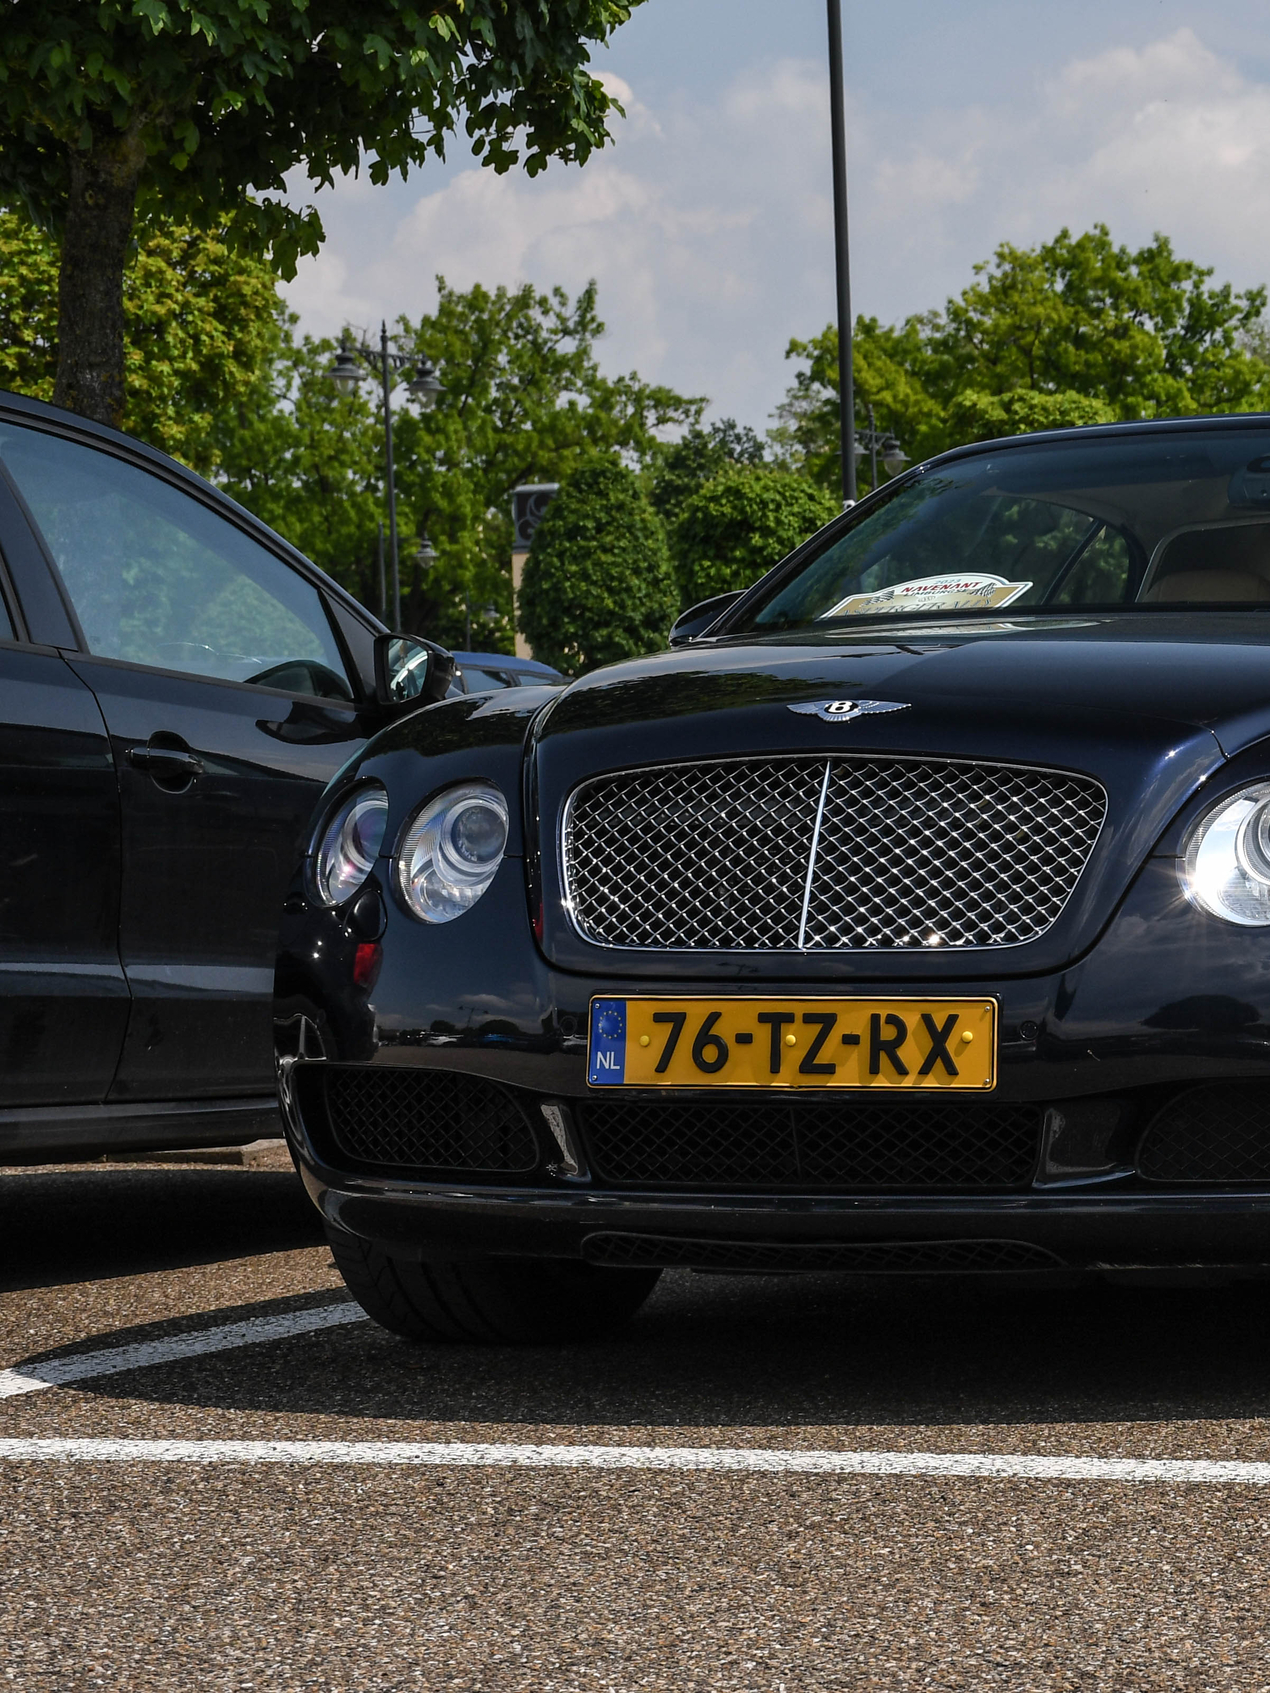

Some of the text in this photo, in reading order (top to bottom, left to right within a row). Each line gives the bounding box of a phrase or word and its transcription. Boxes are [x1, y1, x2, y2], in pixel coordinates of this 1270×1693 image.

[901, 581, 984, 594] NAVENANT
[903, 588, 968, 597] LIMBURGSE
[597, 1011, 960, 1076] NL 76-TZ-RX
